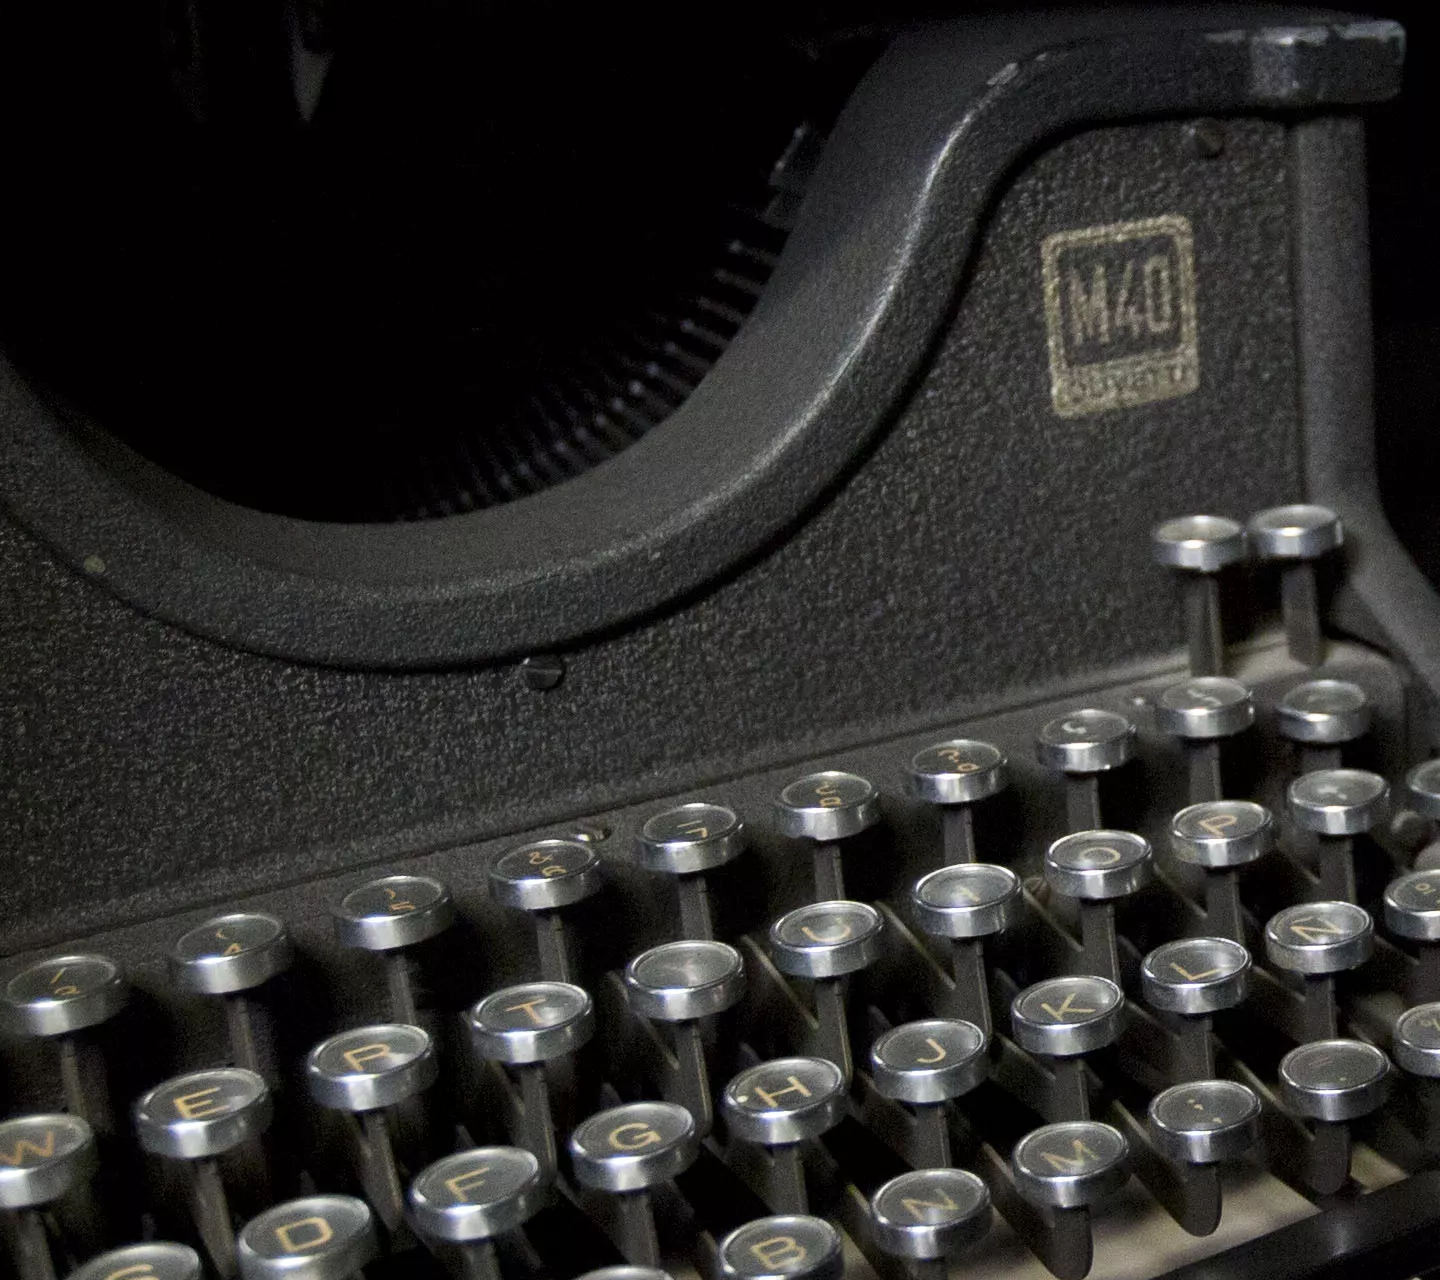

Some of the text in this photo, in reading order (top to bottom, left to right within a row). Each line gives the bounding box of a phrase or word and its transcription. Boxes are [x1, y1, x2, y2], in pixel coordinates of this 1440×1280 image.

[1067, 254, 1173, 347] M40
[1197, 813, 1238, 838] P
[1168, 961, 1233, 982] L
[504, 996, 548, 1025] T
[1040, 992, 1098, 1024] K
[915, 1037, 948, 1064] J
[172, 1086, 230, 1121] E
[753, 1074, 813, 1109] H
[607, 1121, 663, 1152] G
[1039, 1138, 1101, 1174] M
[444, 1166, 491, 1203] F
[900, 1186, 961, 1221] N
[274, 1216, 335, 1253] D
[749, 1235, 807, 1272] B
